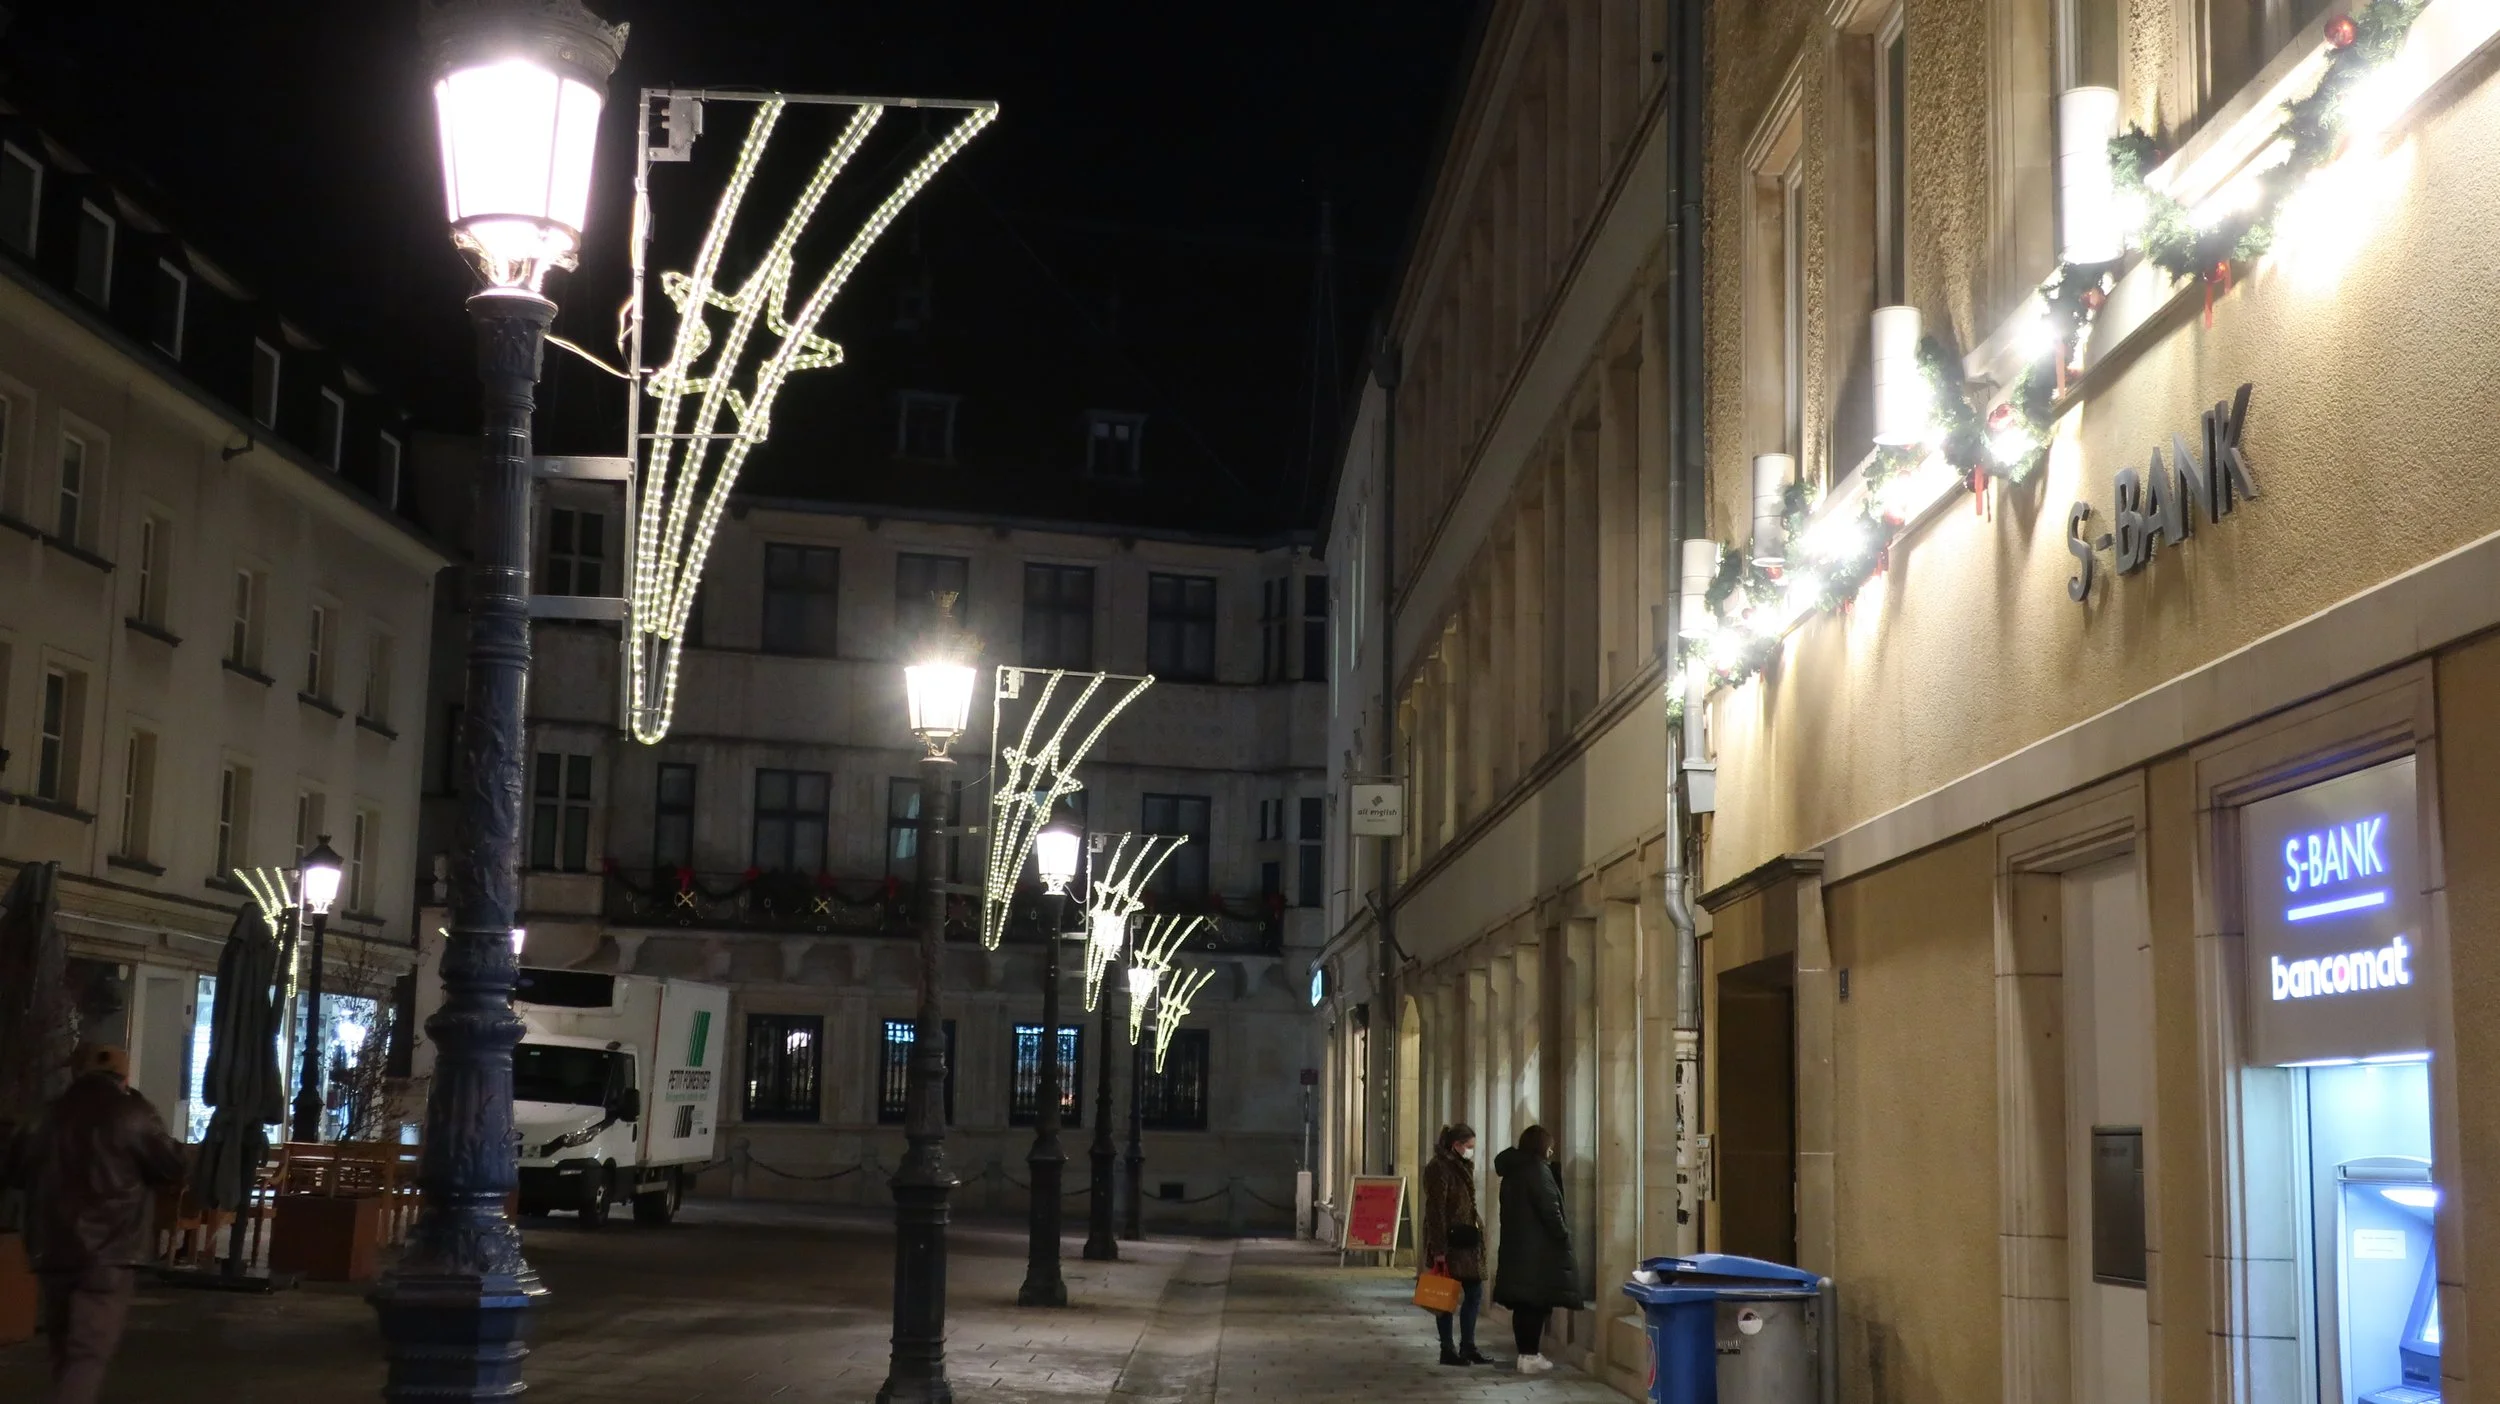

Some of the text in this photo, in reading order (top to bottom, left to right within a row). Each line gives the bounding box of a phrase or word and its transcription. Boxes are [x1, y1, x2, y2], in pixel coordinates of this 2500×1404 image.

[2068, 383, 2259, 601] S-BANK
[1371, 808, 1398, 816] english
[2286, 818, 2384, 892] S-BANK
[2271, 936, 2409, 1000] bancomat
